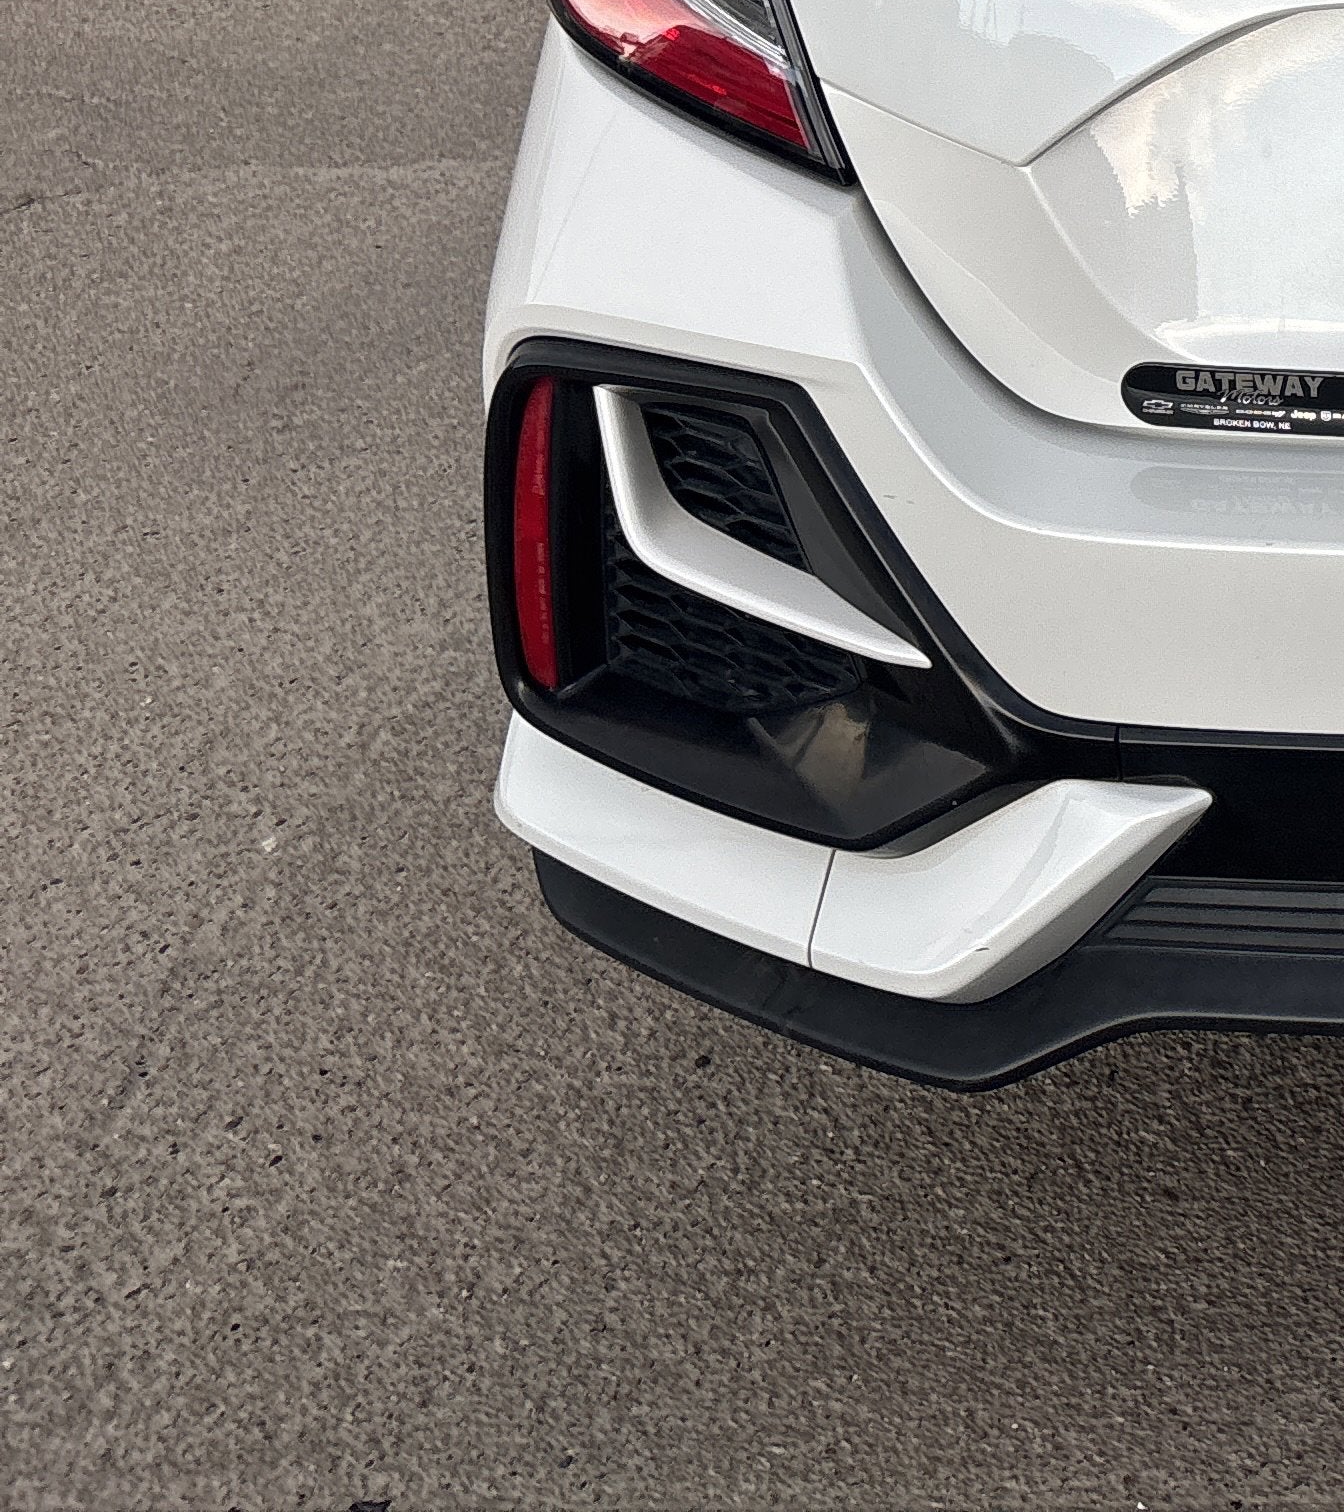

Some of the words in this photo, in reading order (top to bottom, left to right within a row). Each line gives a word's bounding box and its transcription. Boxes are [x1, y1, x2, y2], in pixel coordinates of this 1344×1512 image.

[1175, 370, 1325, 398] GATEWAY
[1217, 388, 1285, 406] Motors
[1290, 409, 1317, 421] Jeep
[1213, 418, 1252, 428] BROKEN
[1253, 420, 1277, 430] BOW,
